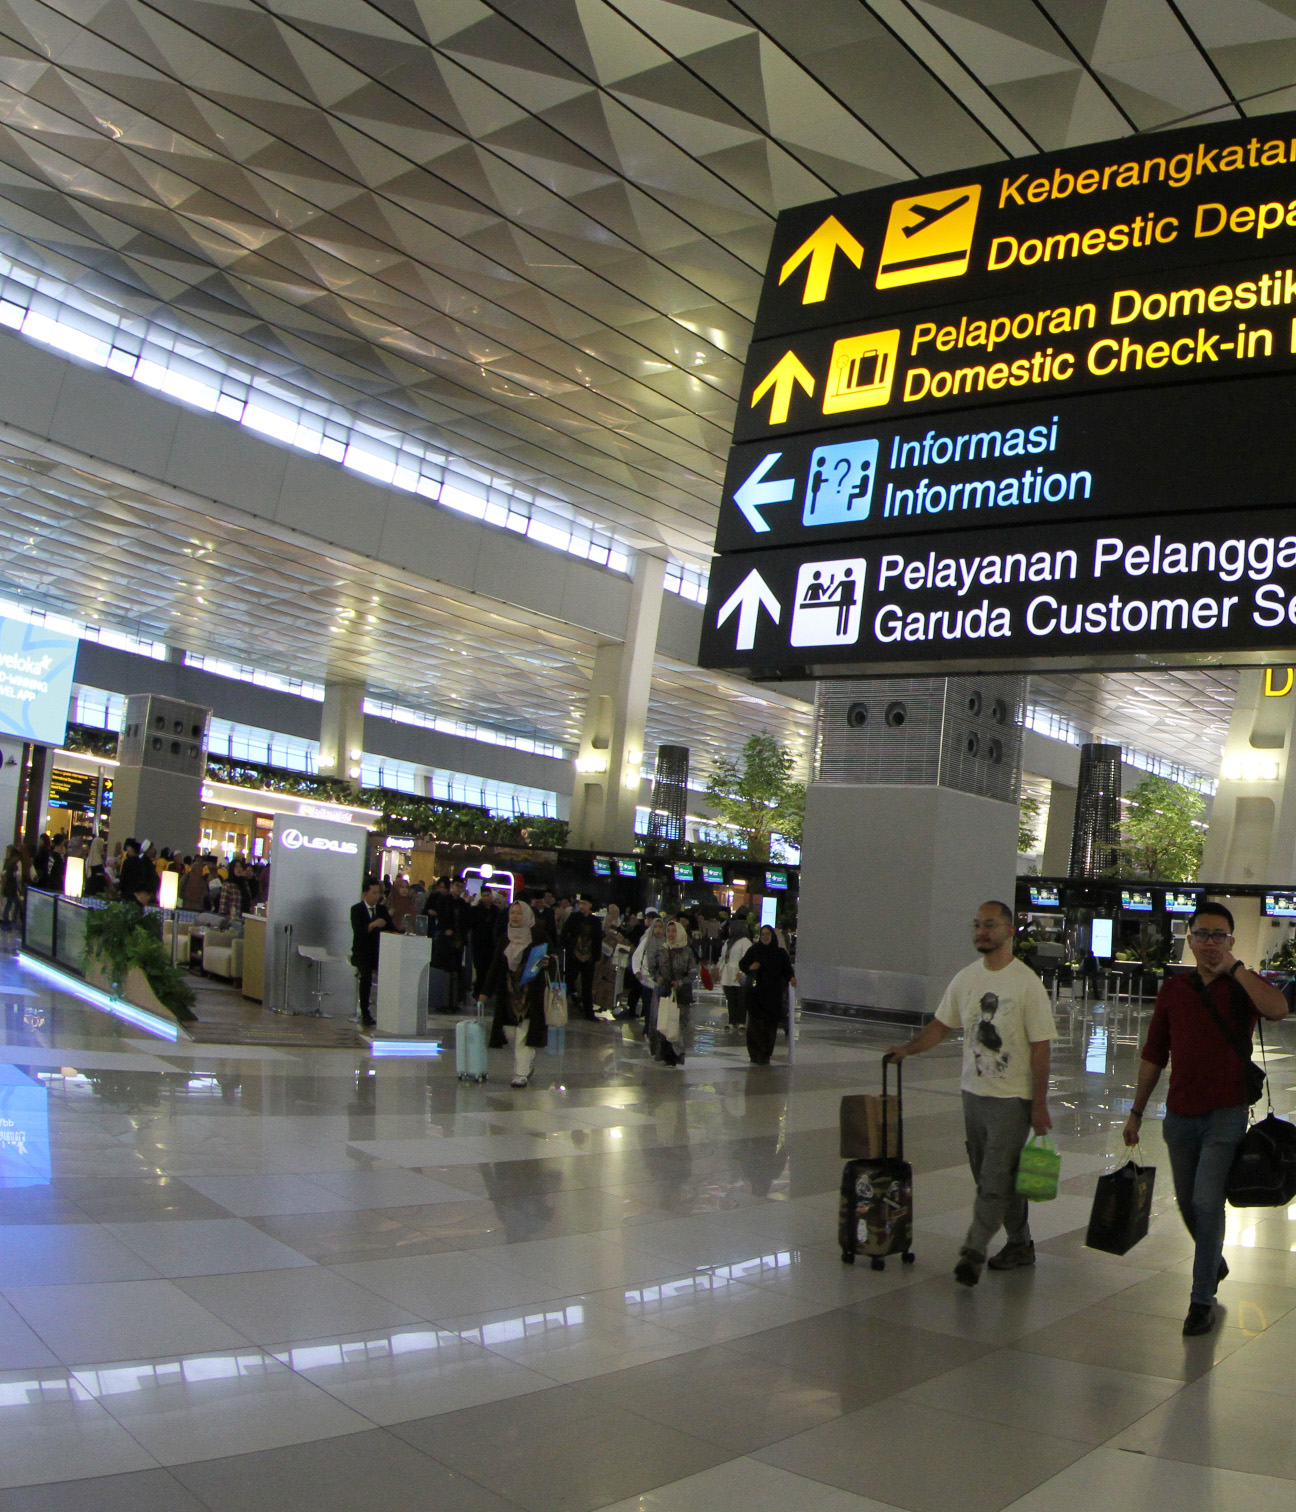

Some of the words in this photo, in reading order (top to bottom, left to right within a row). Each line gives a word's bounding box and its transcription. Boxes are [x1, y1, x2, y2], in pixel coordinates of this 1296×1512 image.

[986, 211, 1179, 272] Domestic
[909, 302, 1097, 357] Pelaporan
[902, 346, 1076, 403] Domestic
[1086, 322, 1274, 376] Check-in
[888, 415, 1059, 470] Informasi
[881, 465, 1093, 518] Information
[877, 549, 1078, 597] Pelayanan
[873, 599, 1012, 644] Garuda
[1025, 594, 1239, 637] Customer
[1264, 667, 1294, 697] D
[303, 835, 358, 855] LEXUS
